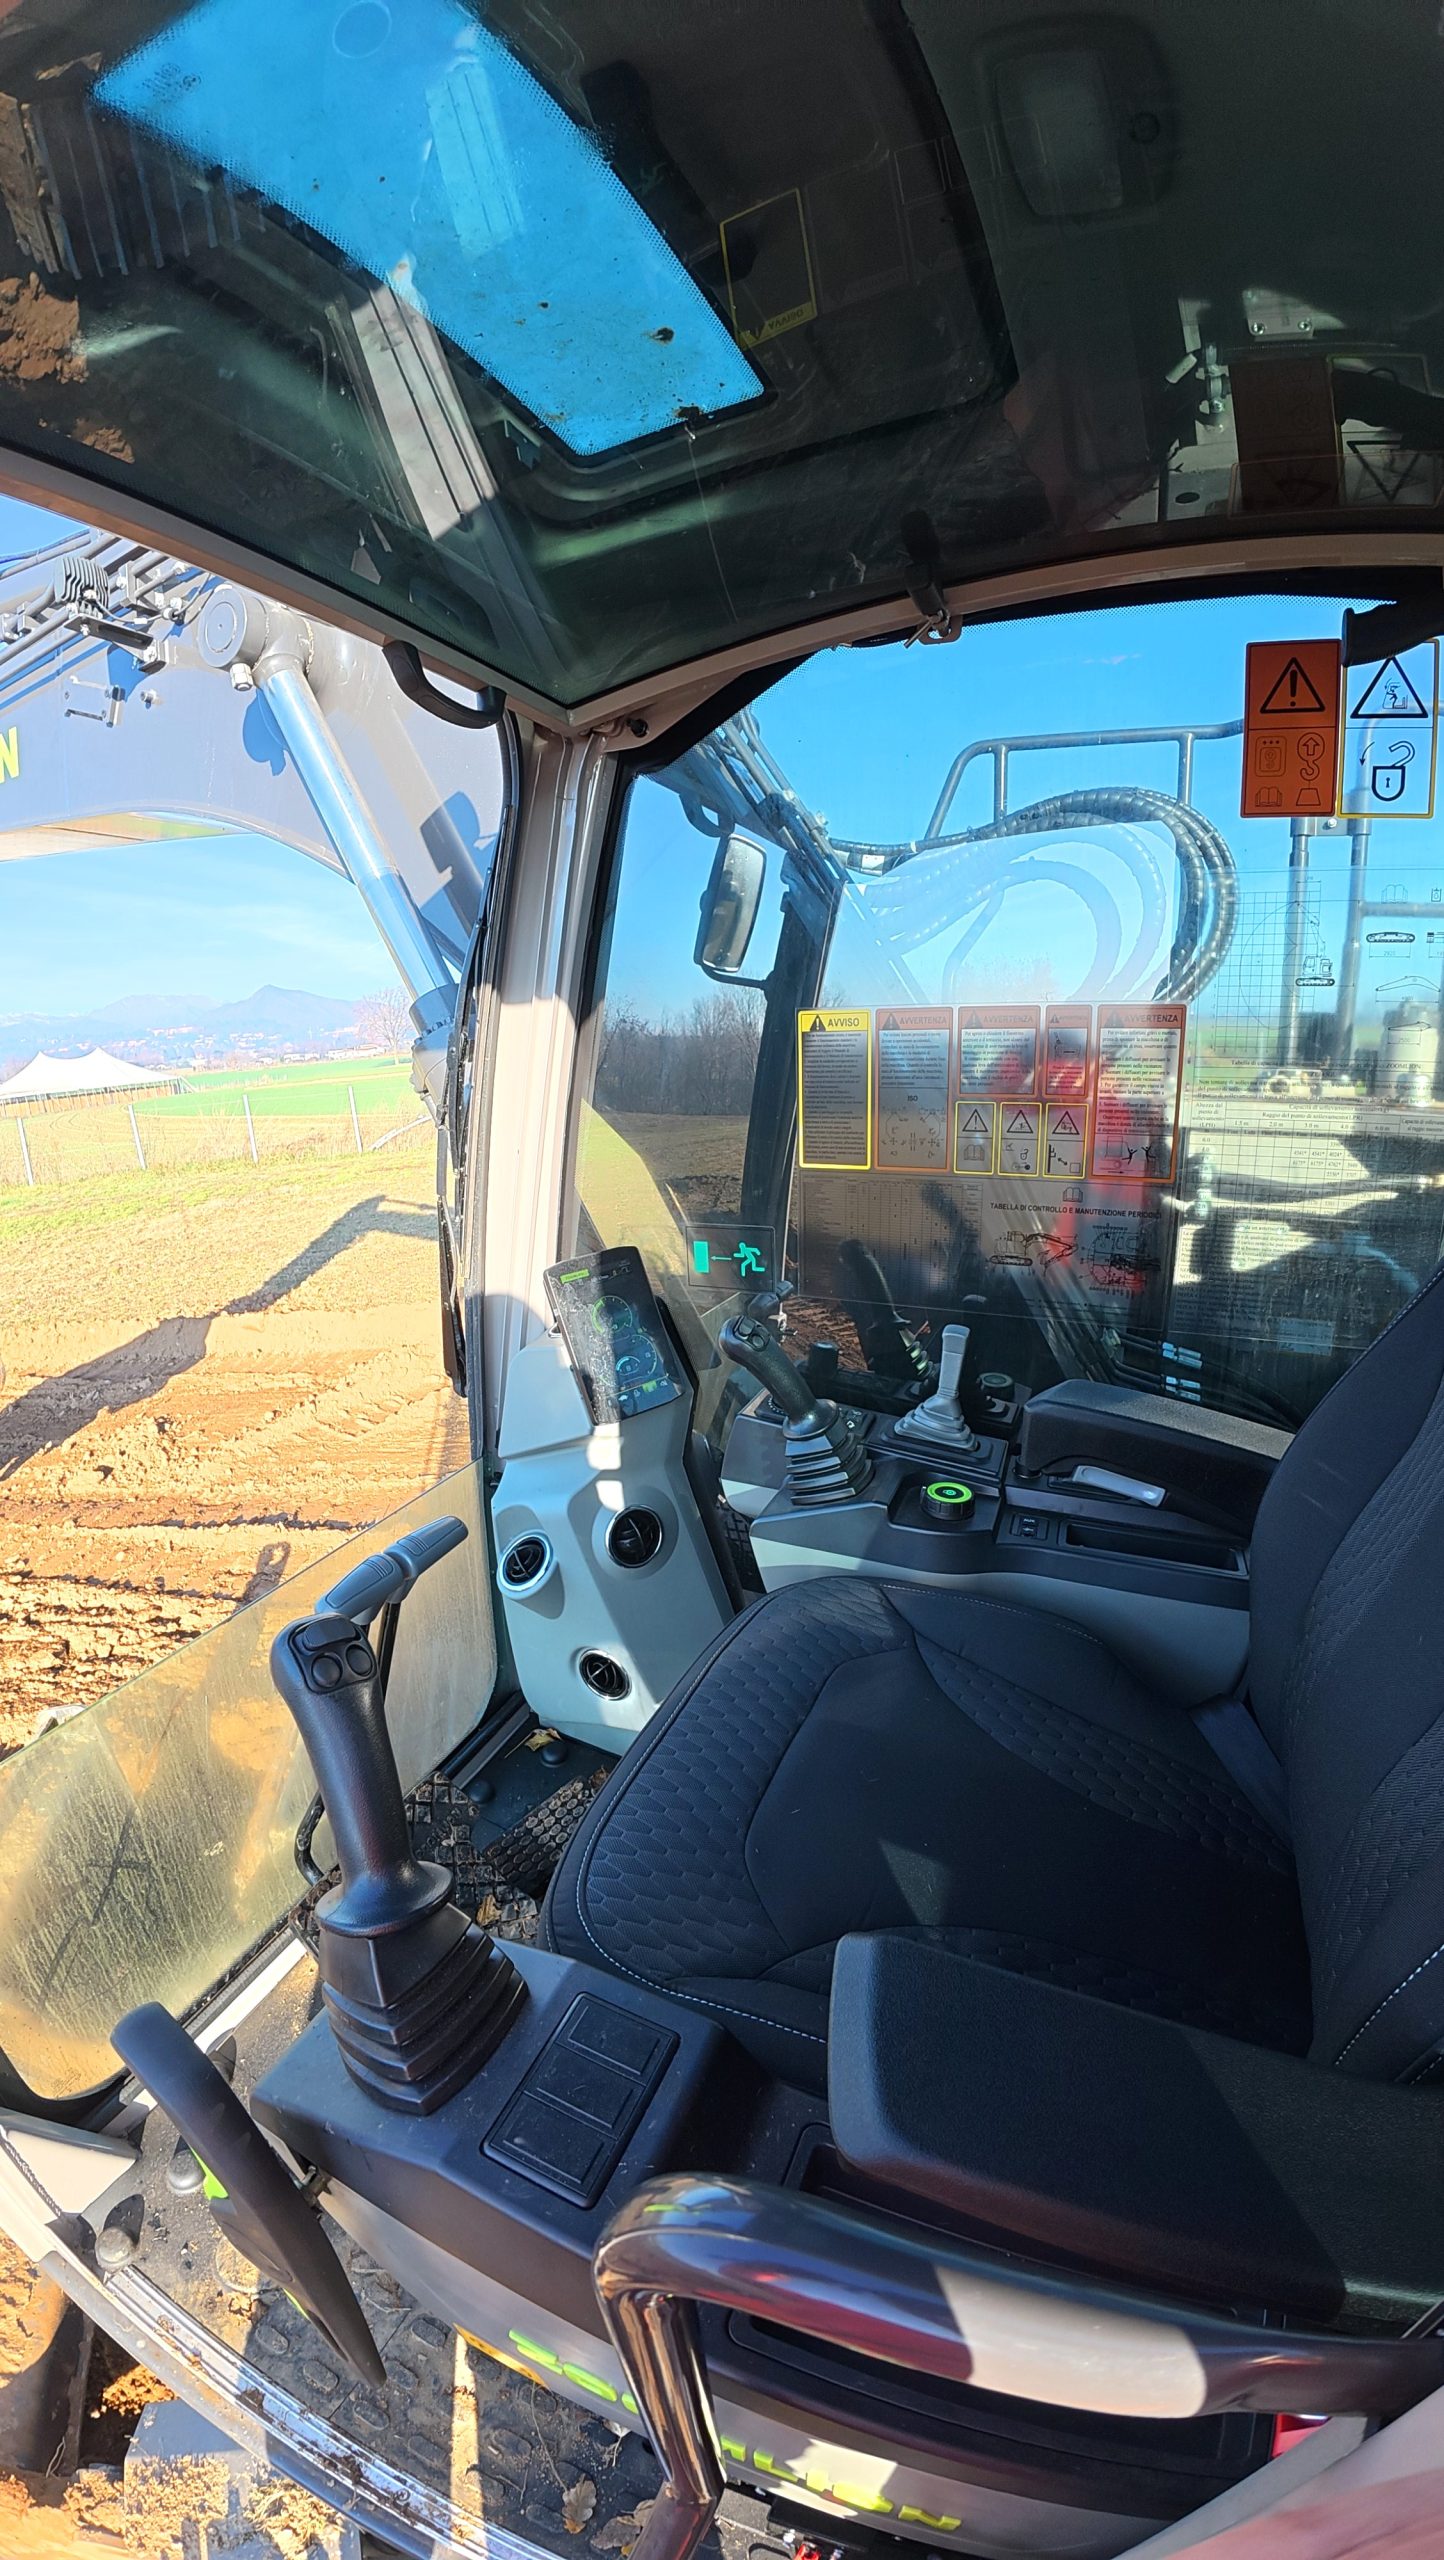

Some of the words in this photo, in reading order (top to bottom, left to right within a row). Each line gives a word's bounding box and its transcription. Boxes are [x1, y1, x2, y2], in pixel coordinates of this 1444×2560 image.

[828, 1017, 860, 1027] AVVISO
[900, 1016, 946, 1024] AVVERTENZA
[1124, 1014, 1178, 1022] AVVERTENZA
[990, 1202, 1018, 1210] TABELLA
[1028, 1205, 1067, 1214] CONTROLLO
[1075, 1208, 1126, 1217] MANUTENZIONE
